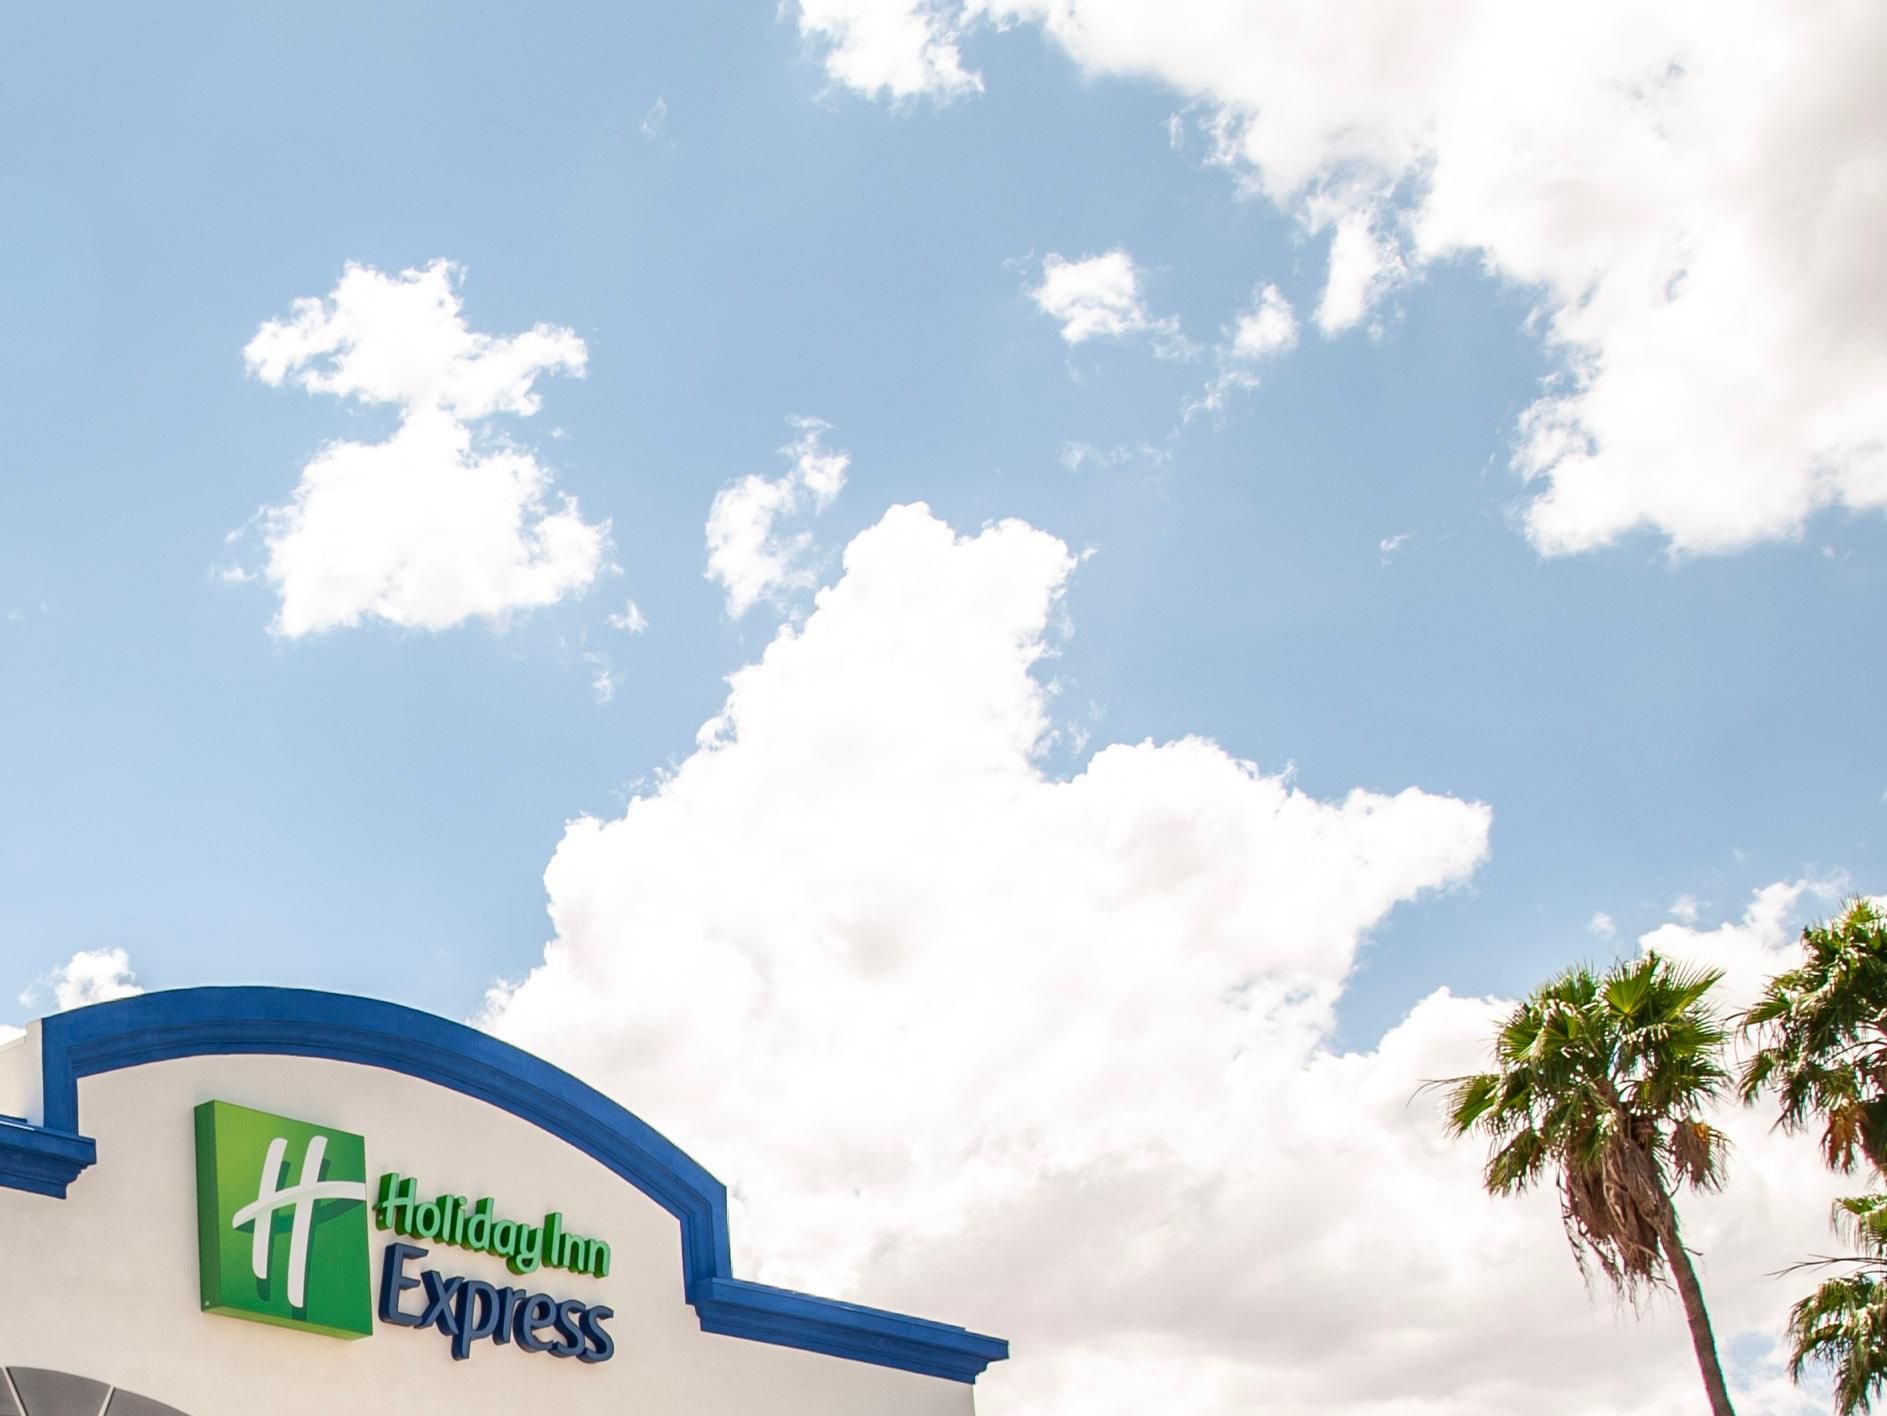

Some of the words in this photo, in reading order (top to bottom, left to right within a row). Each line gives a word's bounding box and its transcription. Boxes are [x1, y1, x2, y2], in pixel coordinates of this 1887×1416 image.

[374, 1172, 544, 1275] Holiday
[543, 1212, 611, 1277] Inn
[379, 1242, 615, 1363] Express
